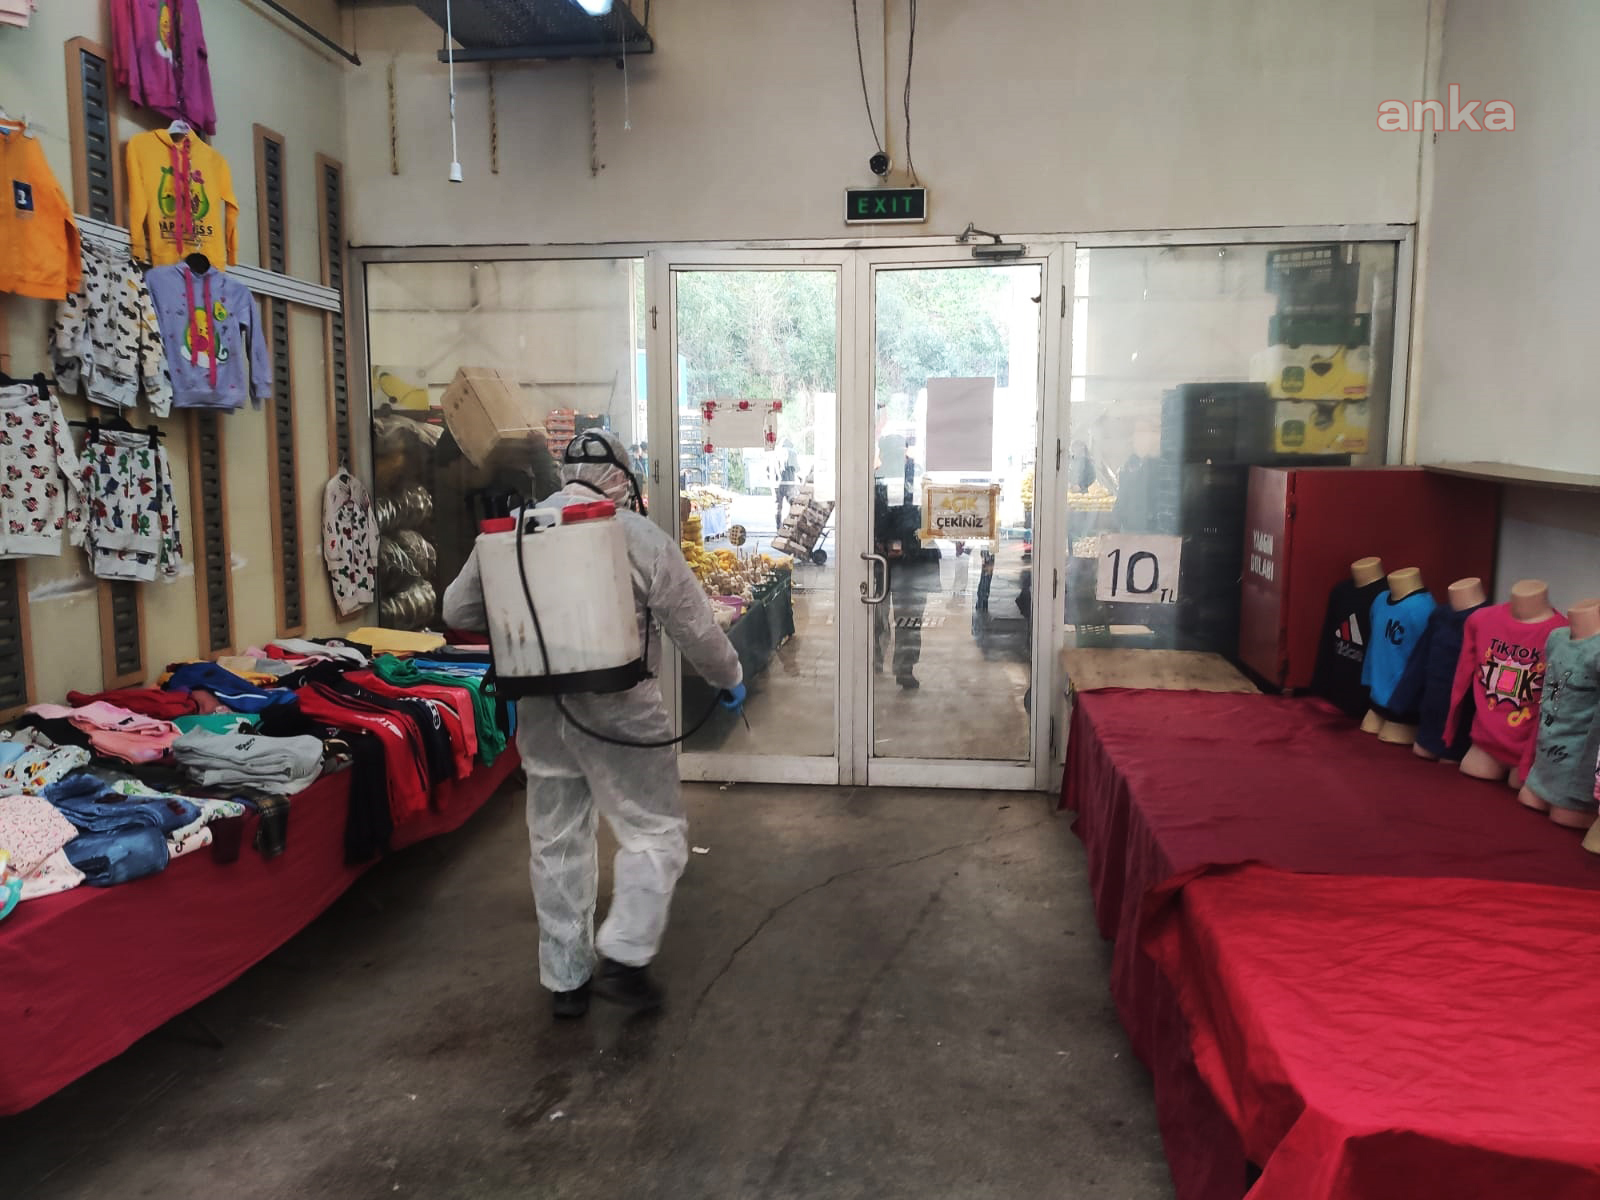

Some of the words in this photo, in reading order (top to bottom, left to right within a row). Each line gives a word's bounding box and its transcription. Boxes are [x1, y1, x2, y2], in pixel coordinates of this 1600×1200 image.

[858, 196, 913, 214] EXIT
[936, 514, 984, 530] ÇEKİNİZ
[1107, 548, 1159, 597] 10
[1160, 588, 1176, 603] TL
